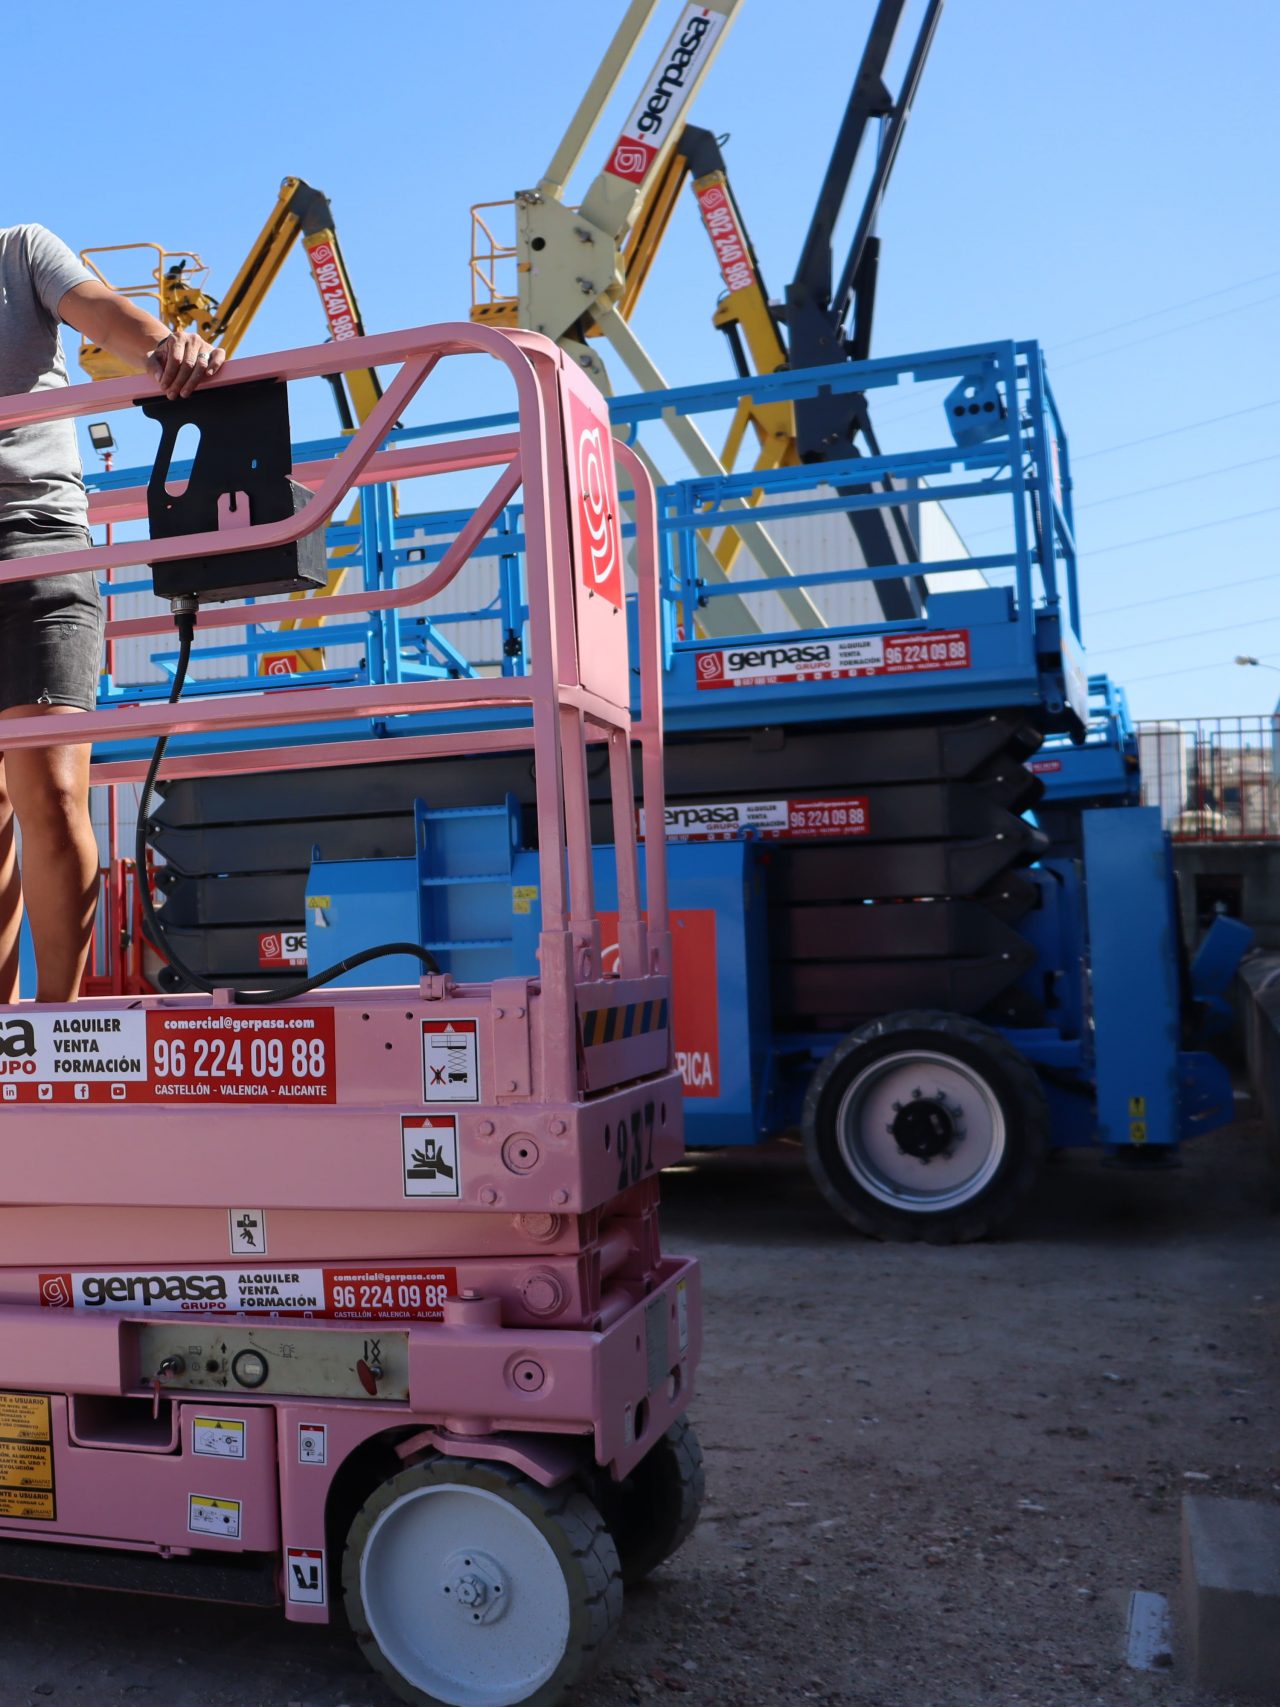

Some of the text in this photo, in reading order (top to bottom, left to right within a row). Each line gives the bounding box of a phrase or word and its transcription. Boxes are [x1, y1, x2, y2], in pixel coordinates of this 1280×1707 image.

[637, 16, 710, 135] gerpasa
[707, 207, 752, 290] 902 240 988
[316, 263, 355, 341] 902 240 988
[728, 644, 830, 671] gerpasa
[885, 641, 966, 664] 96 224 09 88
[664, 806, 739, 827] erpasa
[790, 808, 865, 827] 96 224 09 88
[53, 1018, 121, 1033] ALQUILER
[164, 1016, 315, 1033] comercial@gerpasa.com
[53, 1039, 100, 1053] VENTA
[54, 1055, 141, 1073] FORMACIÓN
[153, 1037, 326, 1078] 96 224 09 88
[674, 1051, 713, 1087] RICA
[154, 1081, 210, 1095] CASTELLÓN
[220, 1084, 268, 1096] VALENCIA
[278, 1084, 327, 1096] ALICANTE
[238, 1274, 299, 1284] ALQUILER
[333, 1272, 446, 1282] comercial@gerpasa.com
[82, 1275, 228, 1306] gerpasa
[238, 1286, 279, 1295] VENTA
[332, 1284, 448, 1309] 96 224 09 88
[180, 1302, 227, 1310] GRUPO
[239, 1294, 317, 1308] FORMACIÓN
[334, 1309, 372, 1318] CASTELLÓN
[15, 1397, 44, 1405] USUARIO
[17, 1445, 47, 1453] USUARIO
[19, 1492, 49, 1500] USUARIO
